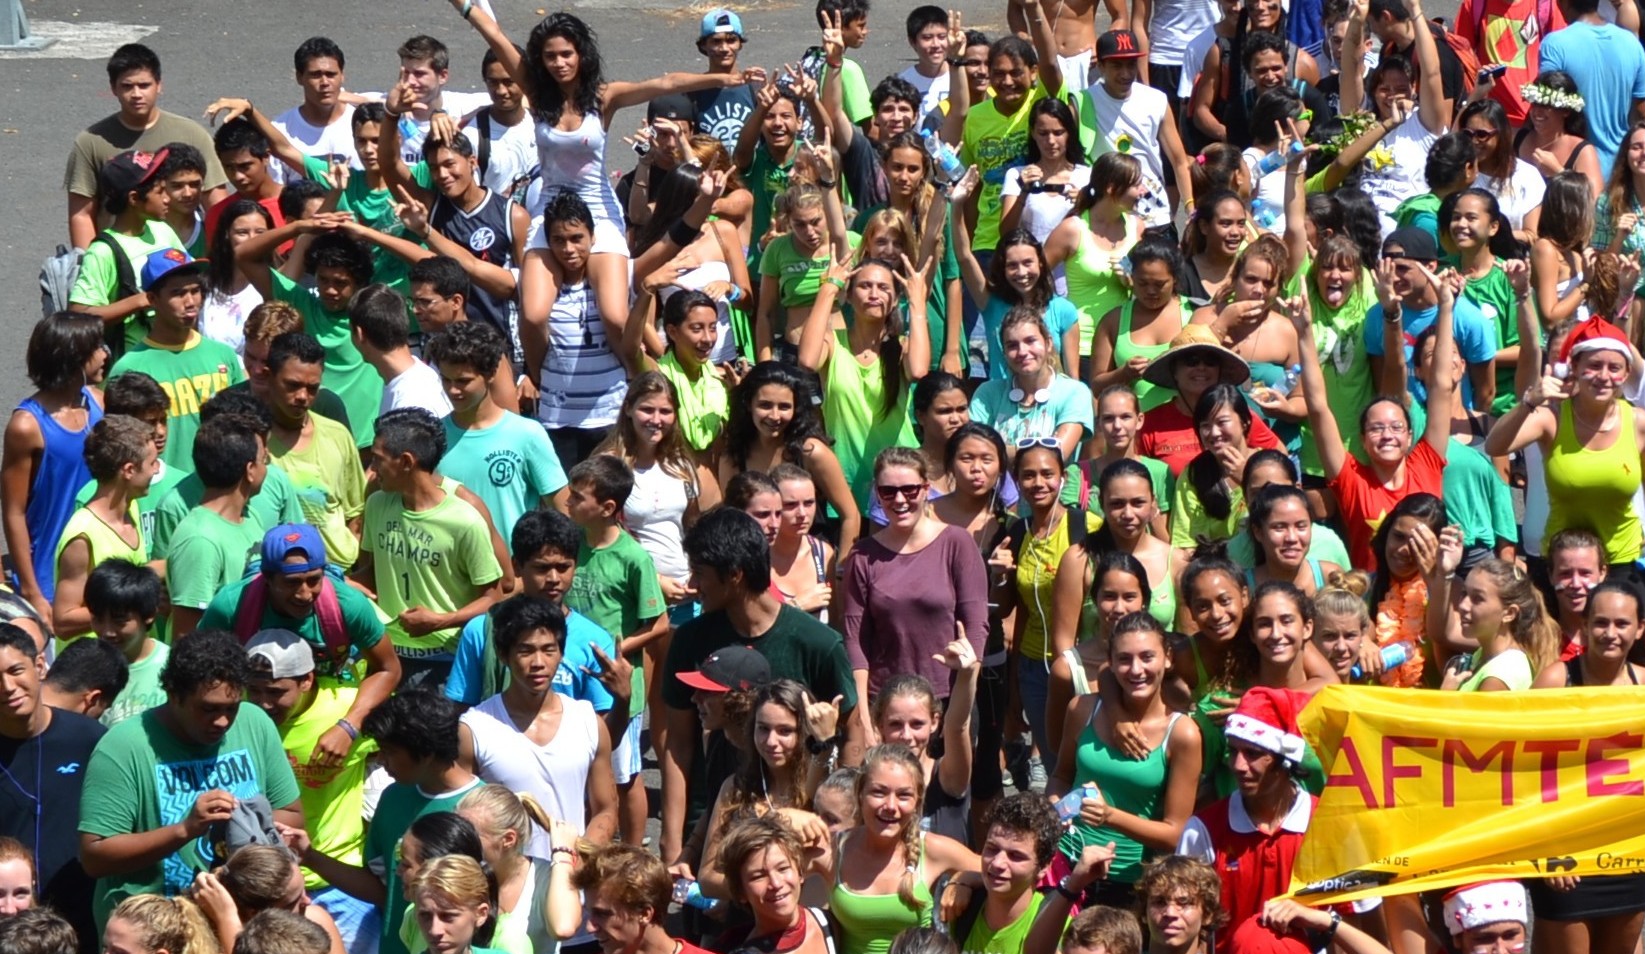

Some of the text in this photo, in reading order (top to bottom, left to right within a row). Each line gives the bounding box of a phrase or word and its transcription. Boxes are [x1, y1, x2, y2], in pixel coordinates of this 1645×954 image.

[699, 101, 752, 133] OLLIST
[380, 532, 442, 568] CHAMPS
[408, 526, 434, 547] MAR
[161, 755, 255, 796] VOLCOM
